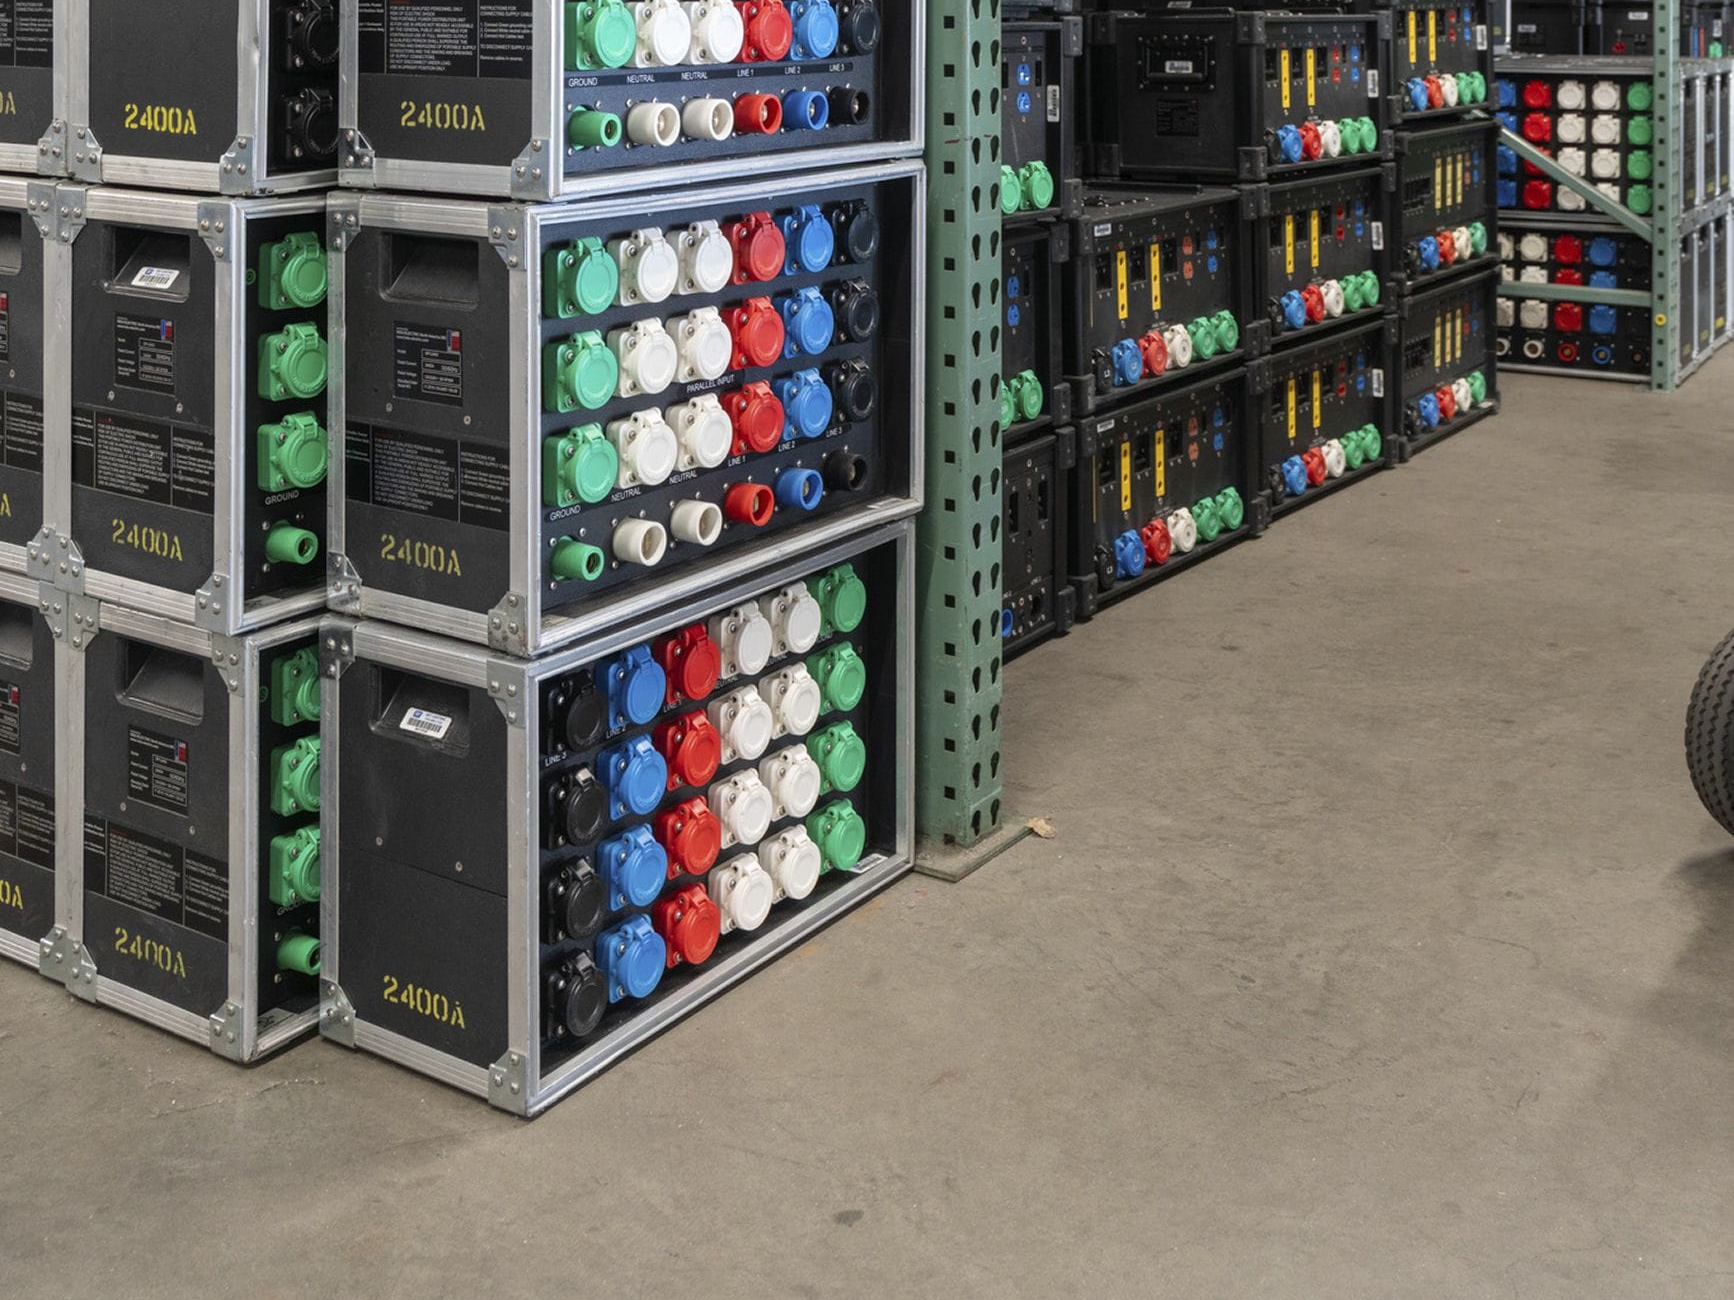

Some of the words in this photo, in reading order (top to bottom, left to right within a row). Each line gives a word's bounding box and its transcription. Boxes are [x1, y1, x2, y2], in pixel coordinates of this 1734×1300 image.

[737, 69, 751, 77] LINE
[785, 66, 797, 75] LINE
[829, 64, 840, 72] LINE
[568, 77, 598, 87] GROUND
[627, 74, 655, 83] NEUTRAL
[681, 71, 708, 81] NEUTRAL
[125, 103, 197, 136] 2400A
[401, 100, 485, 131] 2400A
[686, 380, 715, 393] PARALLEL
[715, 376, 735, 387] INPUT
[778, 441, 791, 452] LINE
[728, 456, 742, 467] LINE
[669, 470, 697, 484] NEUTRAL
[265, 490, 300, 505] GROUND
[611, 488, 641, 502] NEUTRAL
[550, 505, 581, 521] GROUND
[112, 518, 183, 561] 2400A
[381, 534, 462, 576] 2400A
[545, 754, 561, 767] LINE
[114, 927, 186, 979] 2400A
[383, 974, 466, 1029] 2400A
